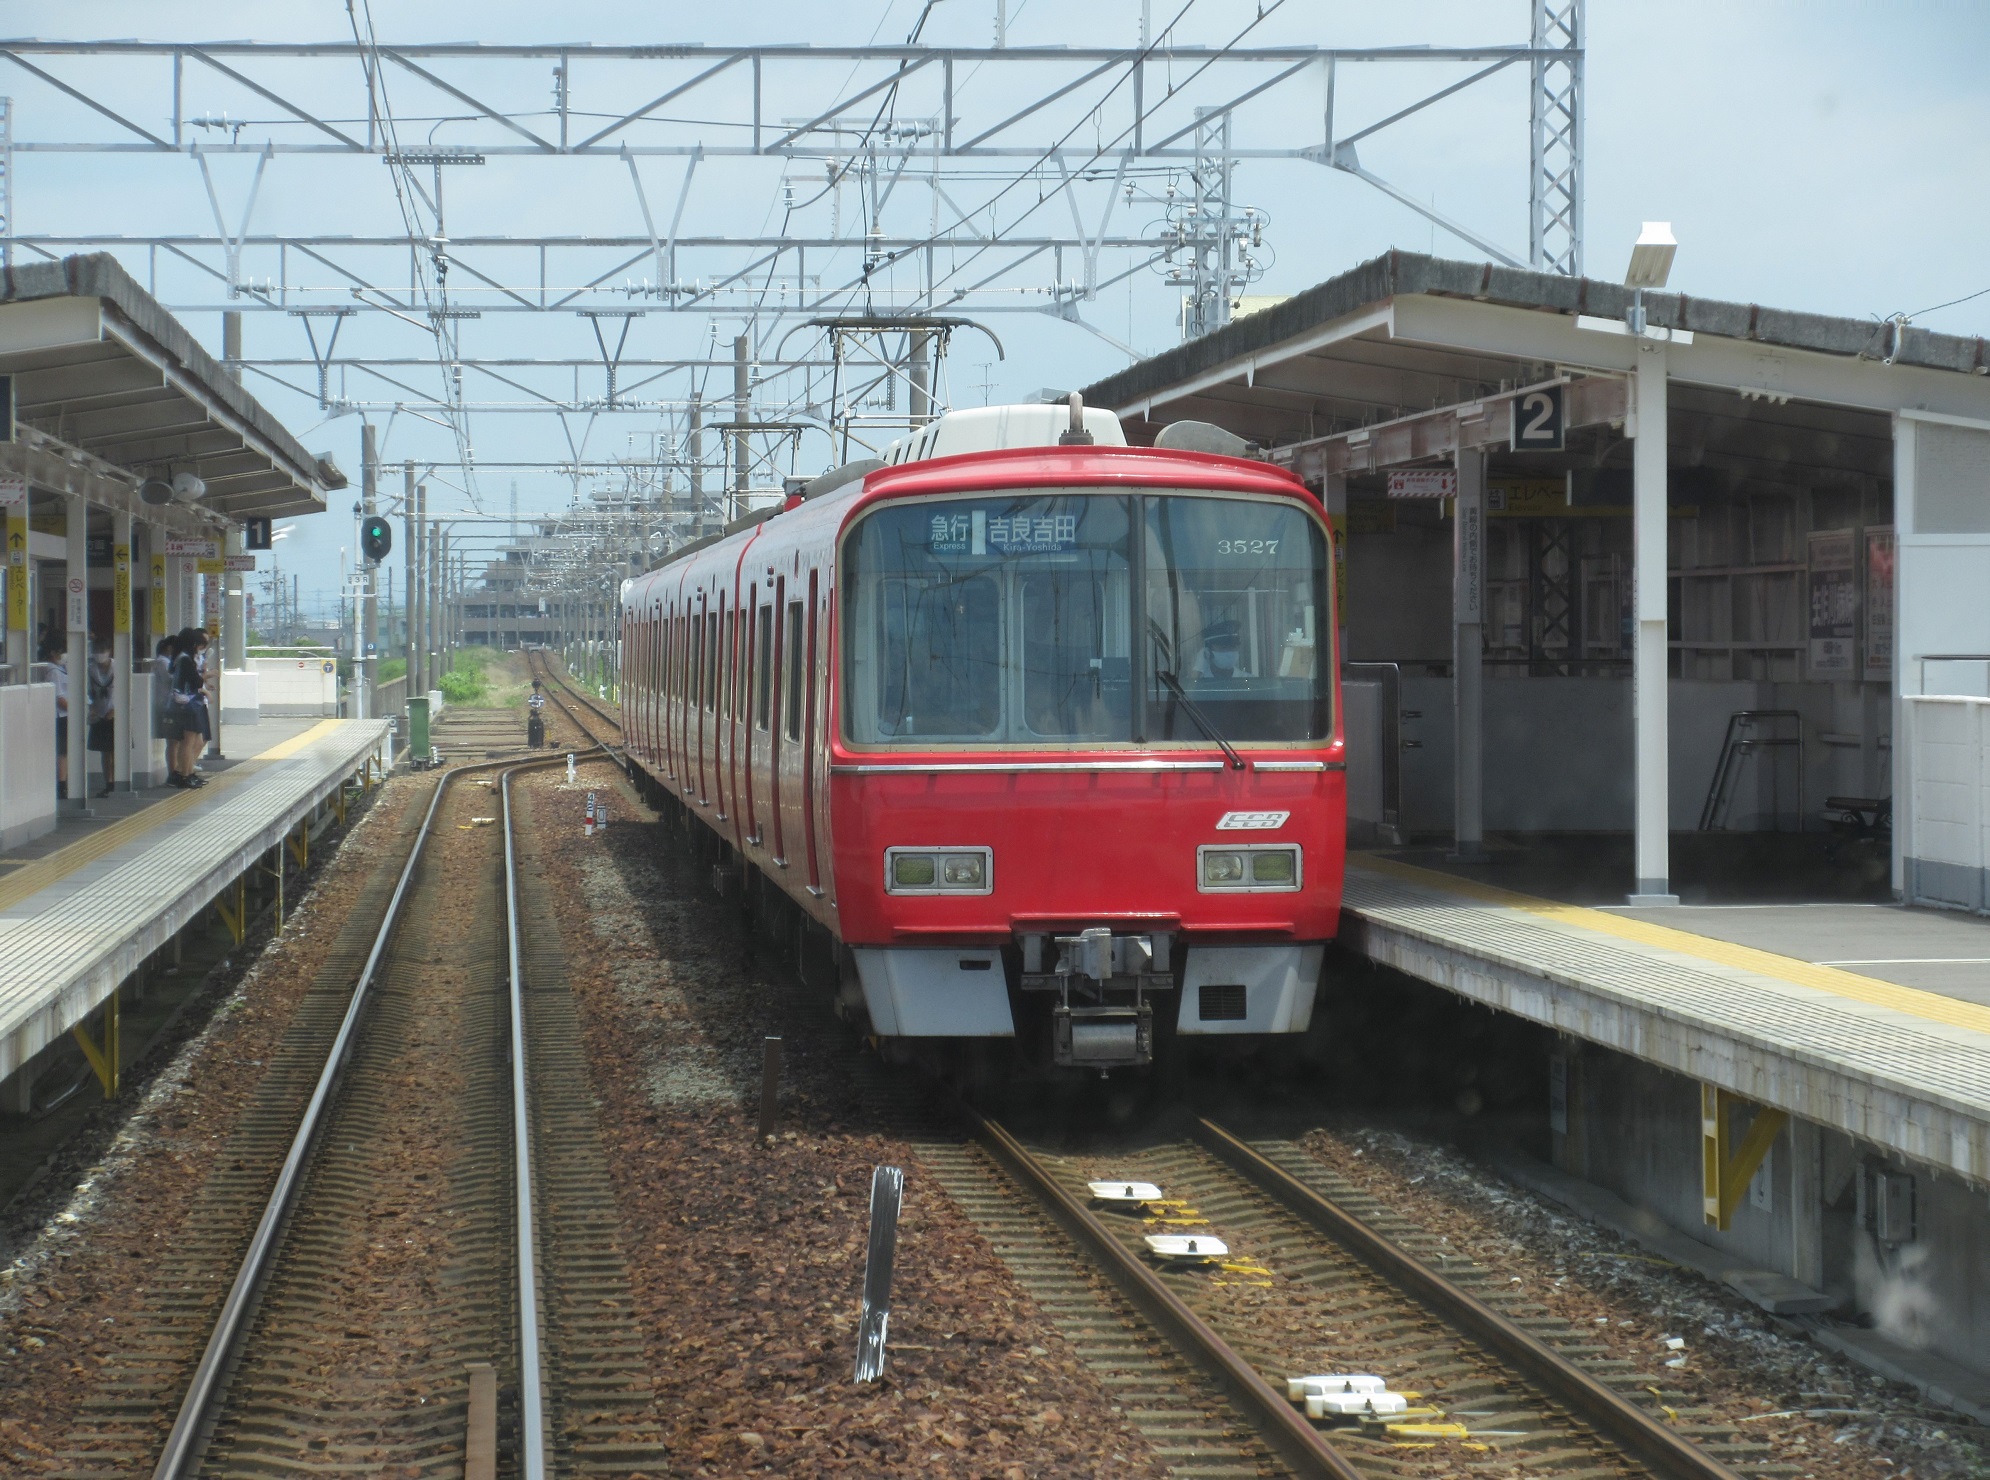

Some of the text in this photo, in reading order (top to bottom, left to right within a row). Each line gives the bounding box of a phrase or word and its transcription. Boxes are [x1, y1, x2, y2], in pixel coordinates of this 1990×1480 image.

[1522, 392, 1554, 439] 2
[252, 521, 263, 544] 1
[931, 514, 969, 541] 急行
[988, 515, 1076, 543] 吉良吉田
[933, 542, 966, 551] Express
[1003, 543, 1062, 551] Kira-Yoshida
[1218, 539, 1279, 554] 3527
